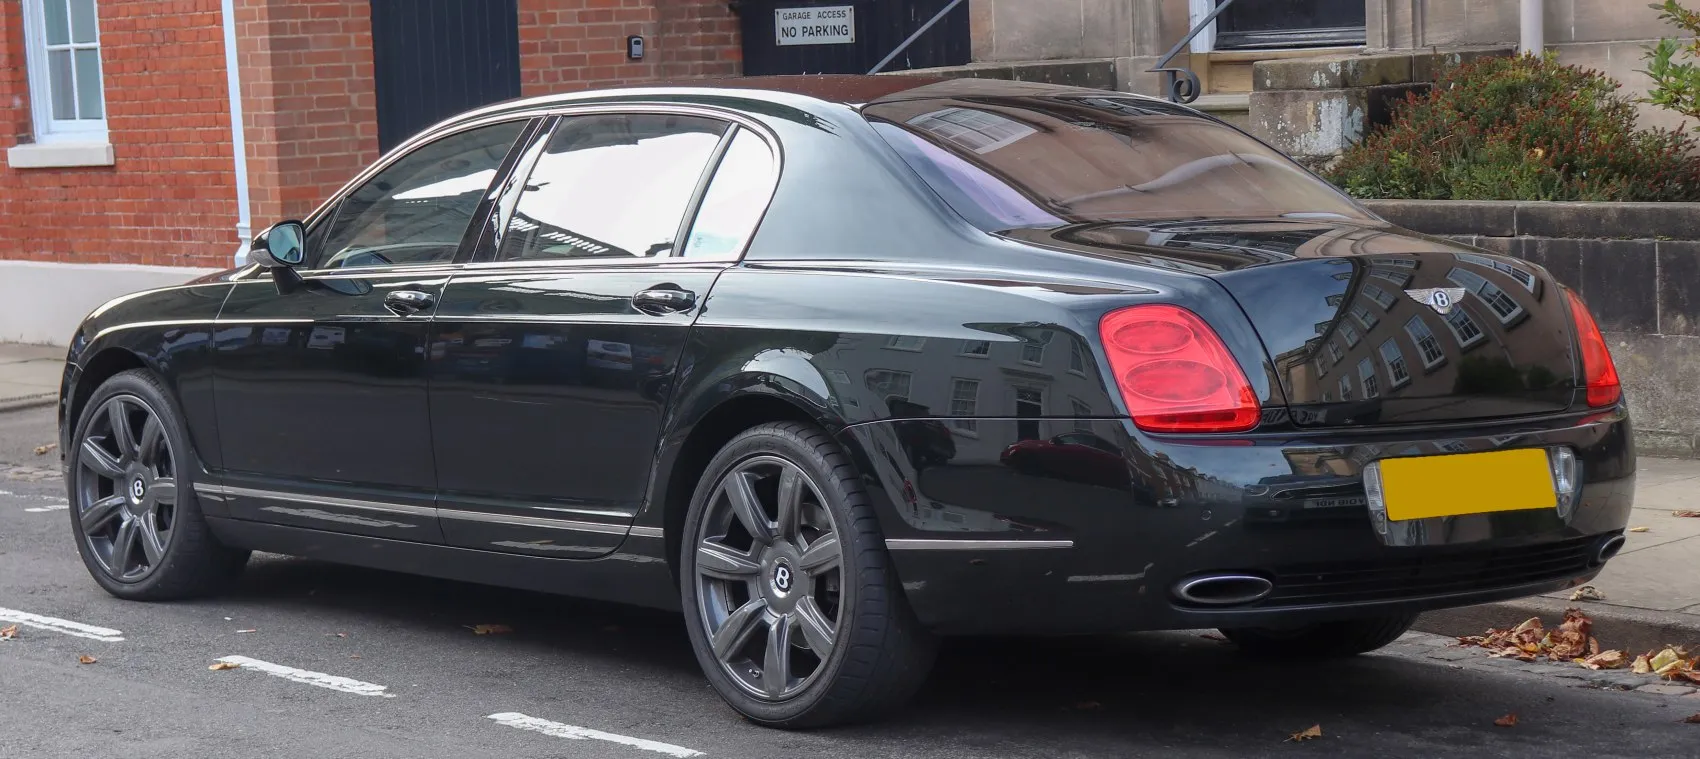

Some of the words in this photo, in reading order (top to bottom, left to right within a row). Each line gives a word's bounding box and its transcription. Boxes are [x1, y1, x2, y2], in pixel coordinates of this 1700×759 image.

[782, 12, 811, 20] GARAGE
[817, 10, 847, 19] ACCESS
[781, 27, 797, 38] NO
[802, 24, 849, 37] PARKING
[1434, 291, 1450, 307] B
[133, 479, 144, 497] B
[775, 566, 790, 589] B
